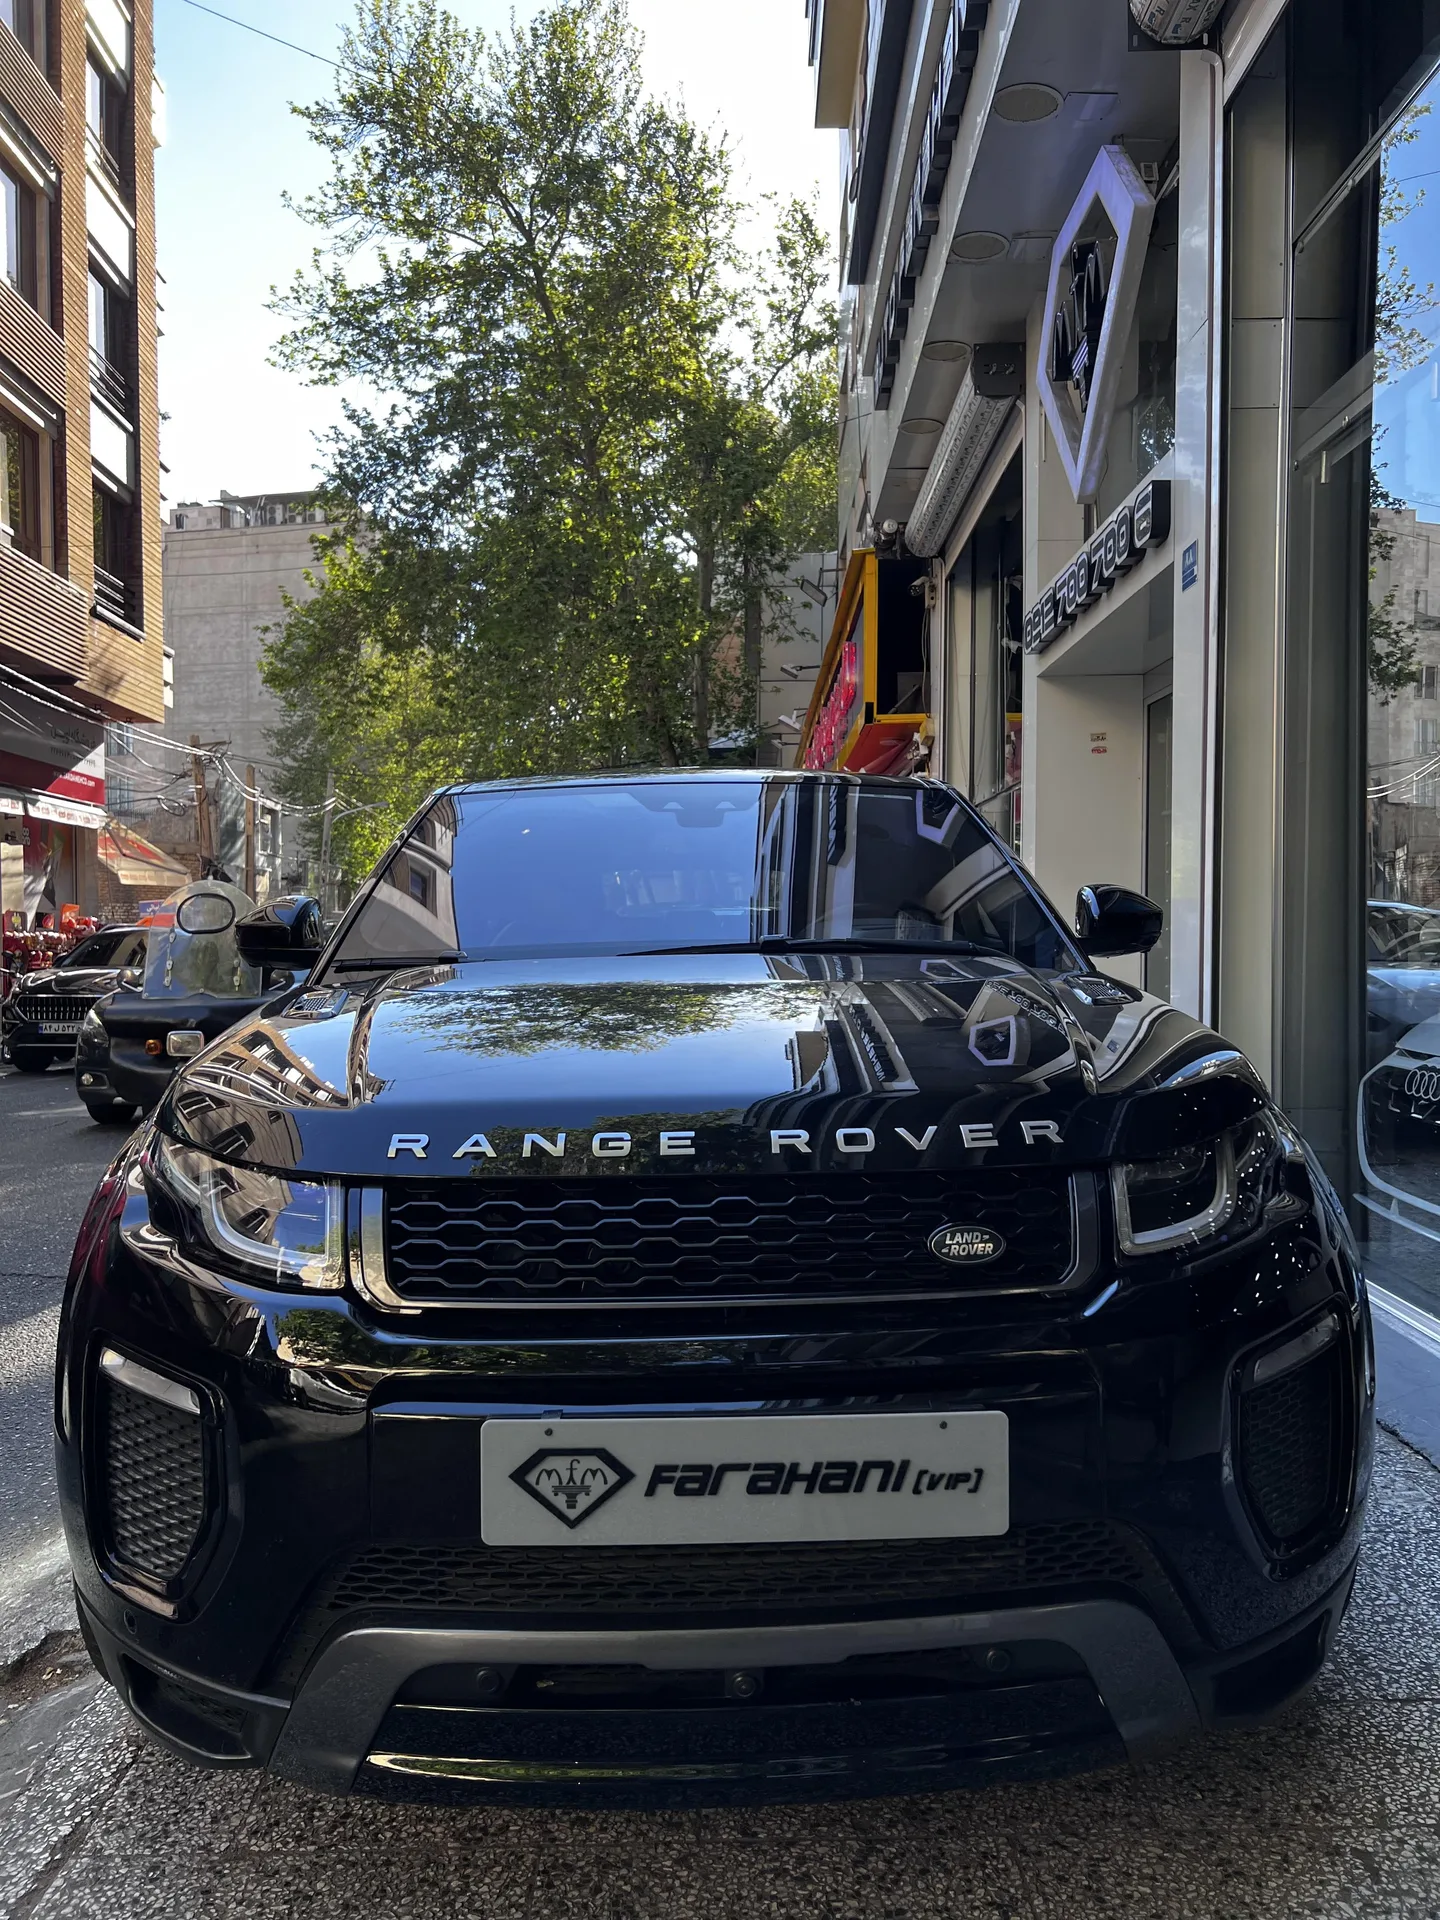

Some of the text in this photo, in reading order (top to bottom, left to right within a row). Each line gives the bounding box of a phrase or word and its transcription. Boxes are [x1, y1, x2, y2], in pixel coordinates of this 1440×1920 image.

[1055, 551, 1089, 626] 700
[1090, 505, 1131, 594] 700
[387, 1120, 1064, 1158] RANGE ROVER
[945, 1232, 981, 1244] LAND
[949, 1243, 993, 1256] ROVER
